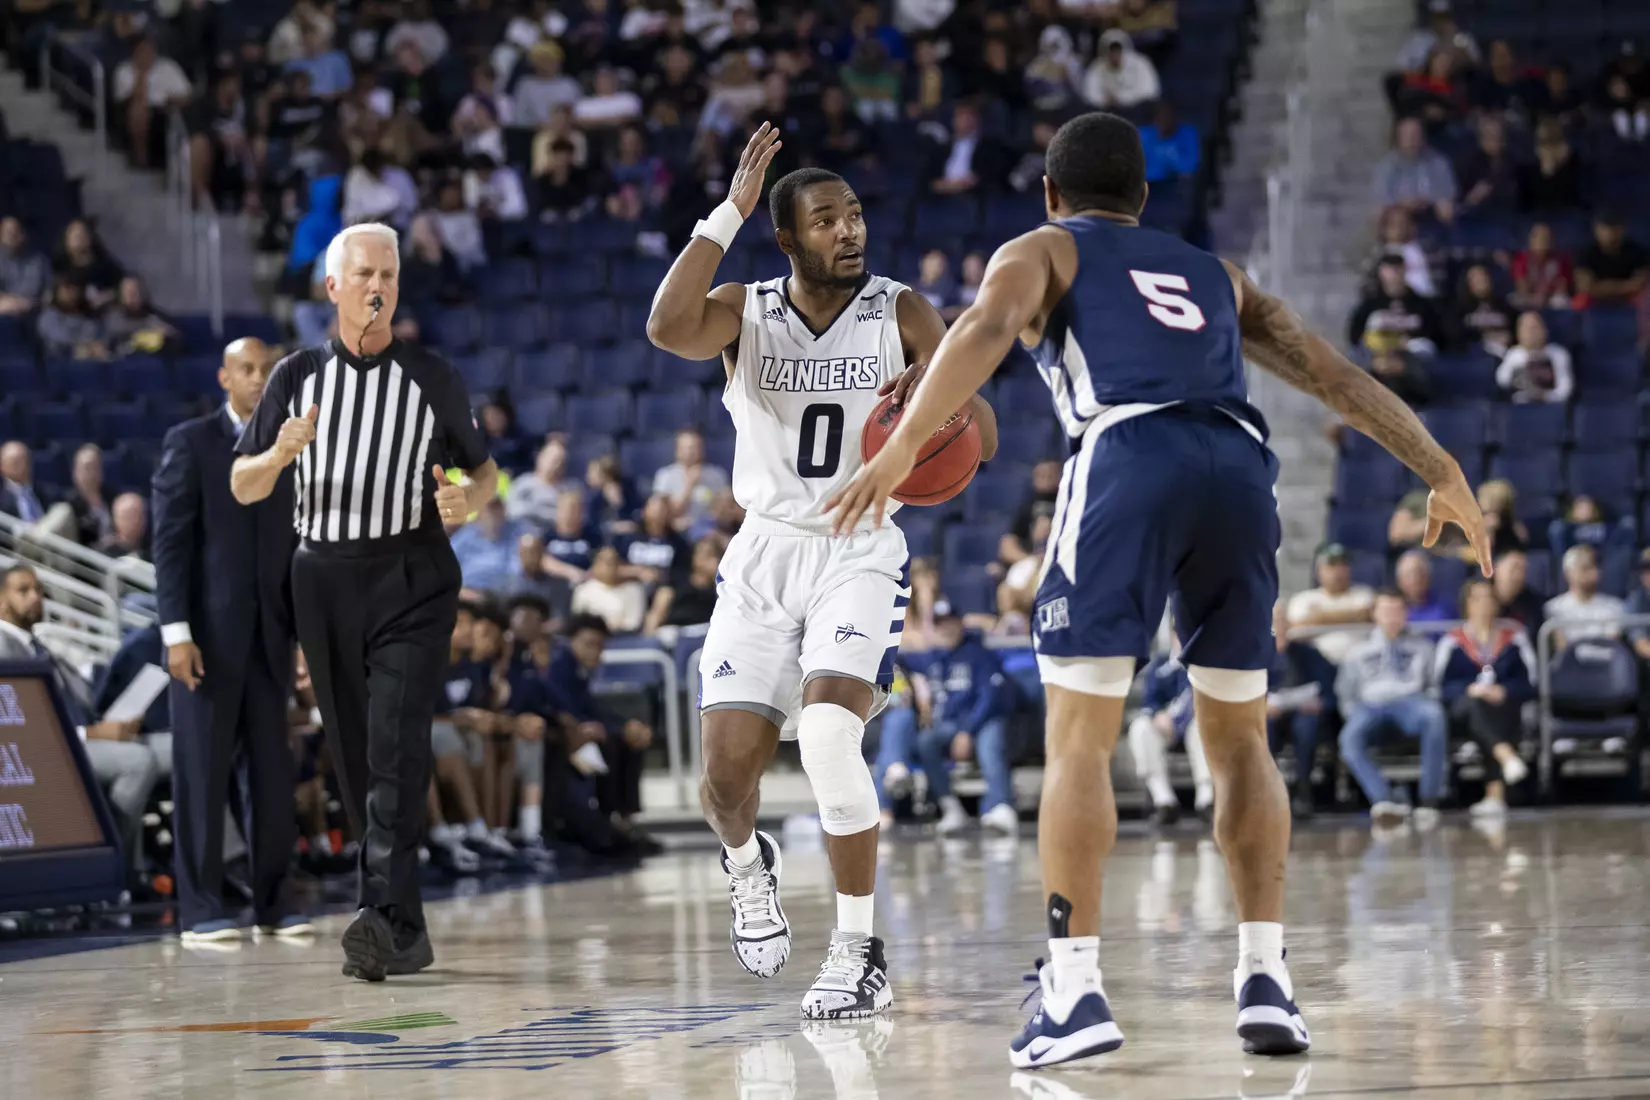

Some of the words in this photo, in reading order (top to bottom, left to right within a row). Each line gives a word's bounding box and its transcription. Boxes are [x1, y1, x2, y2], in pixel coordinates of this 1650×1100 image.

[1129, 269, 1207, 332] 5
[761, 312, 787, 325] adidas
[857, 310, 883, 323] WAC
[759, 355, 880, 392] LANCERS
[797, 403, 845, 478] 0
[712, 669, 737, 680] adidas
